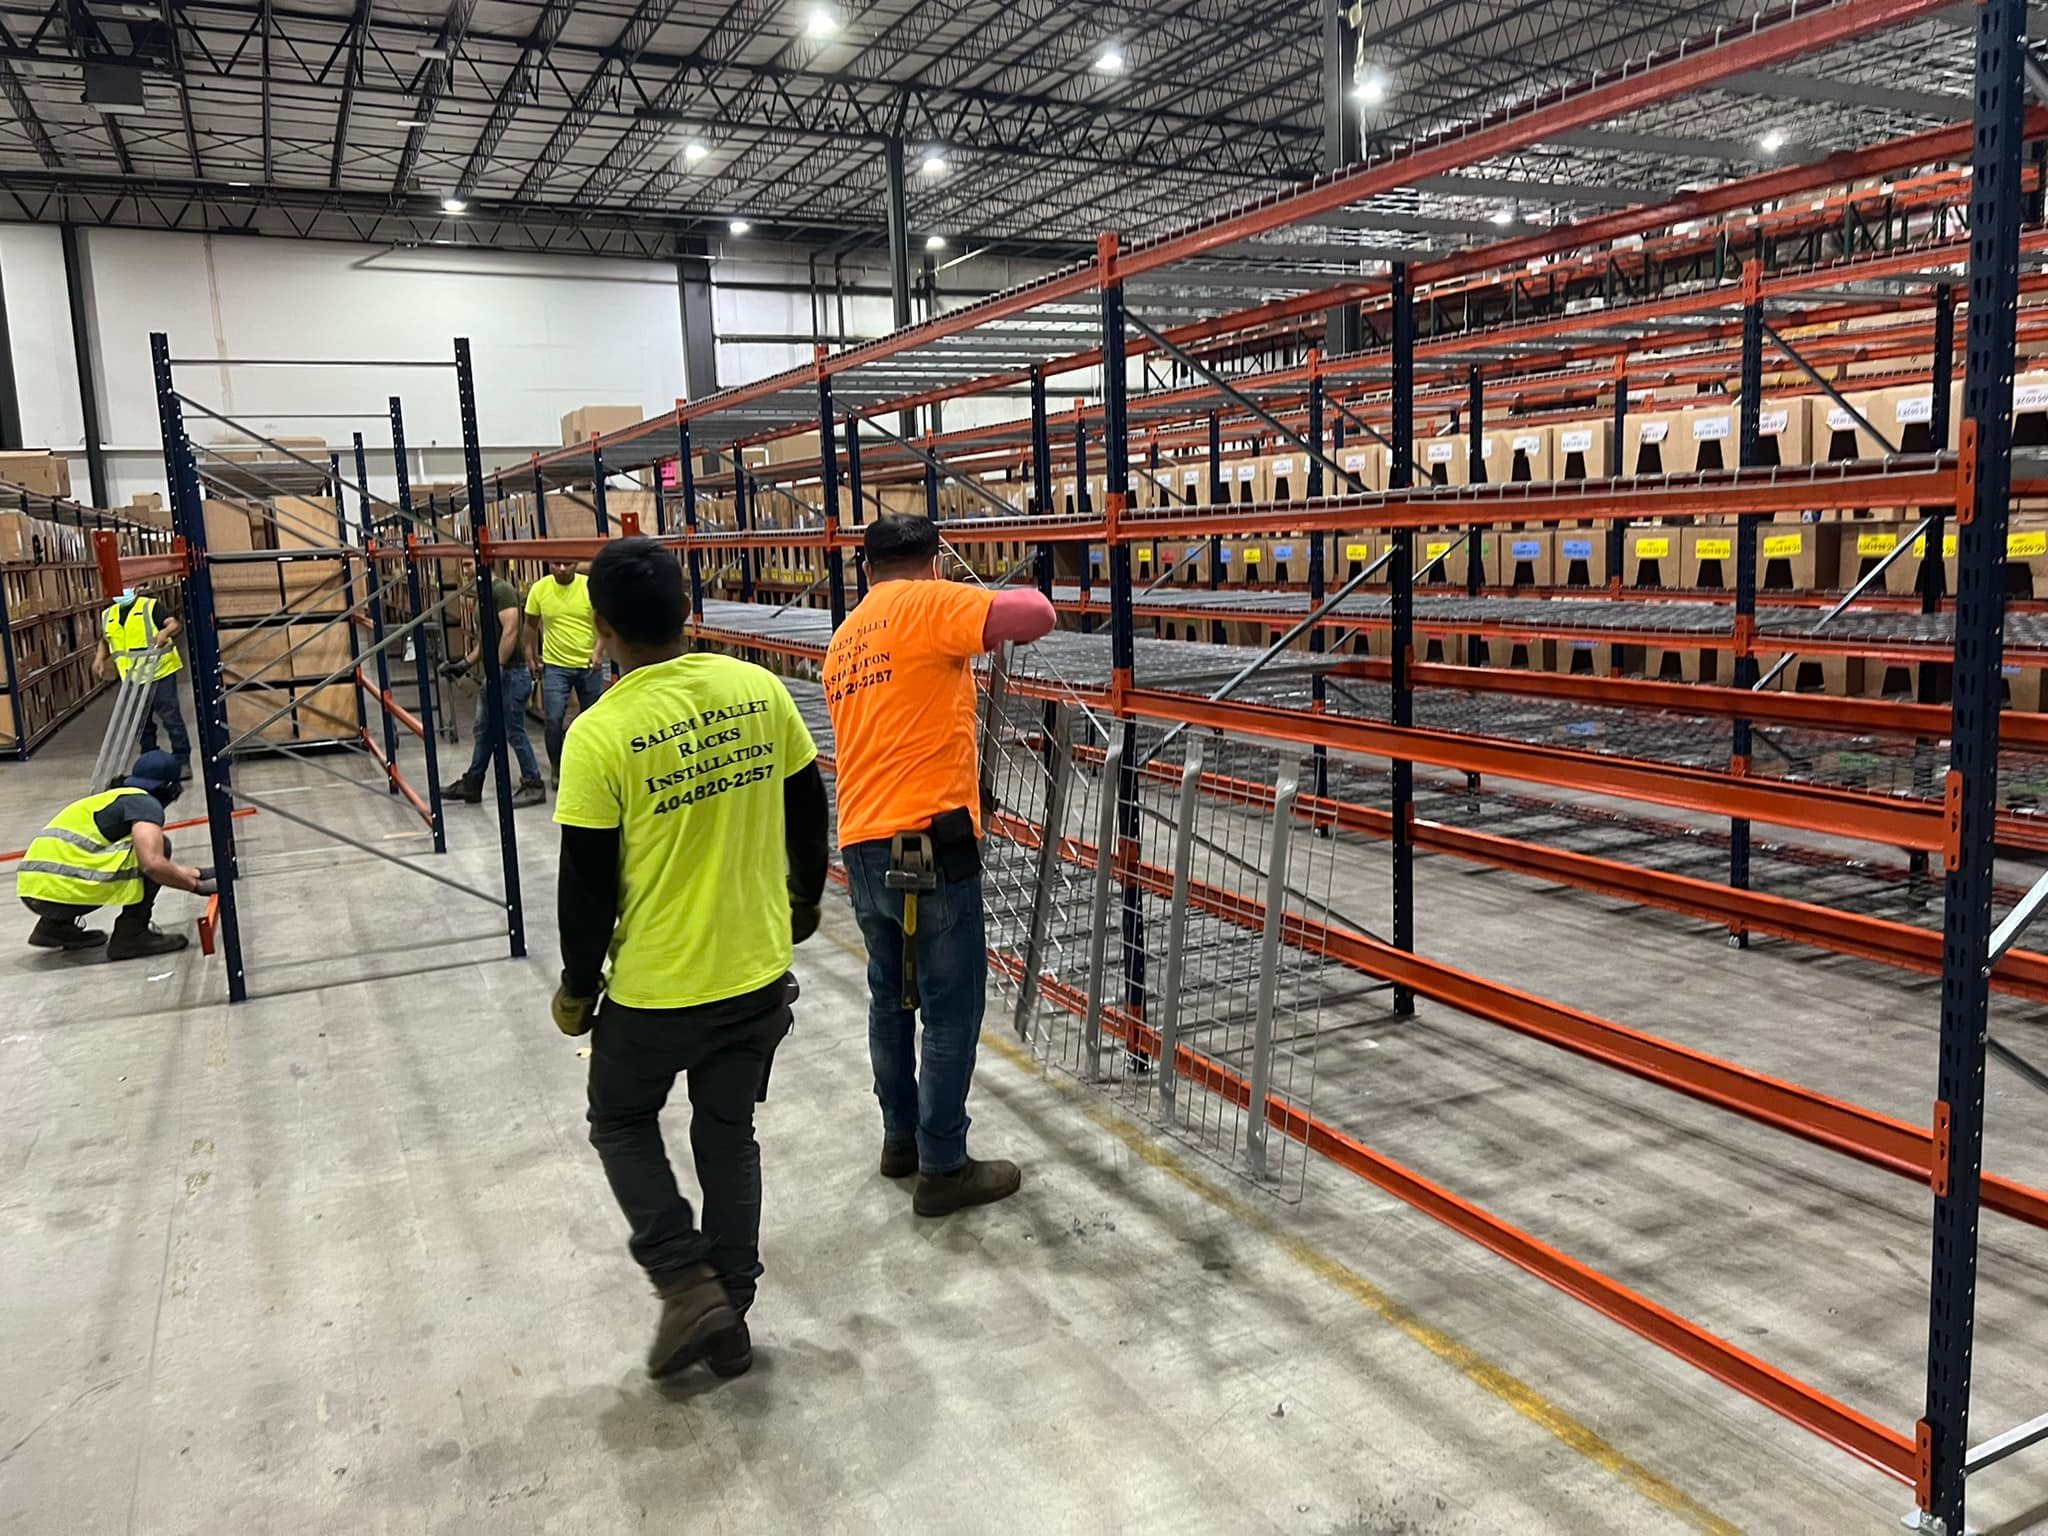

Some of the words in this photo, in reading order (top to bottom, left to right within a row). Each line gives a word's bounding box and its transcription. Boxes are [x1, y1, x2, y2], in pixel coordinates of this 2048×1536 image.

[630, 718, 698, 754] SALEM
[701, 700, 768, 727] PALLET
[678, 727, 741, 758] RACKS
[645, 742, 774, 795] INSTALLATION
[654, 764, 775, 815] 404820-2257
